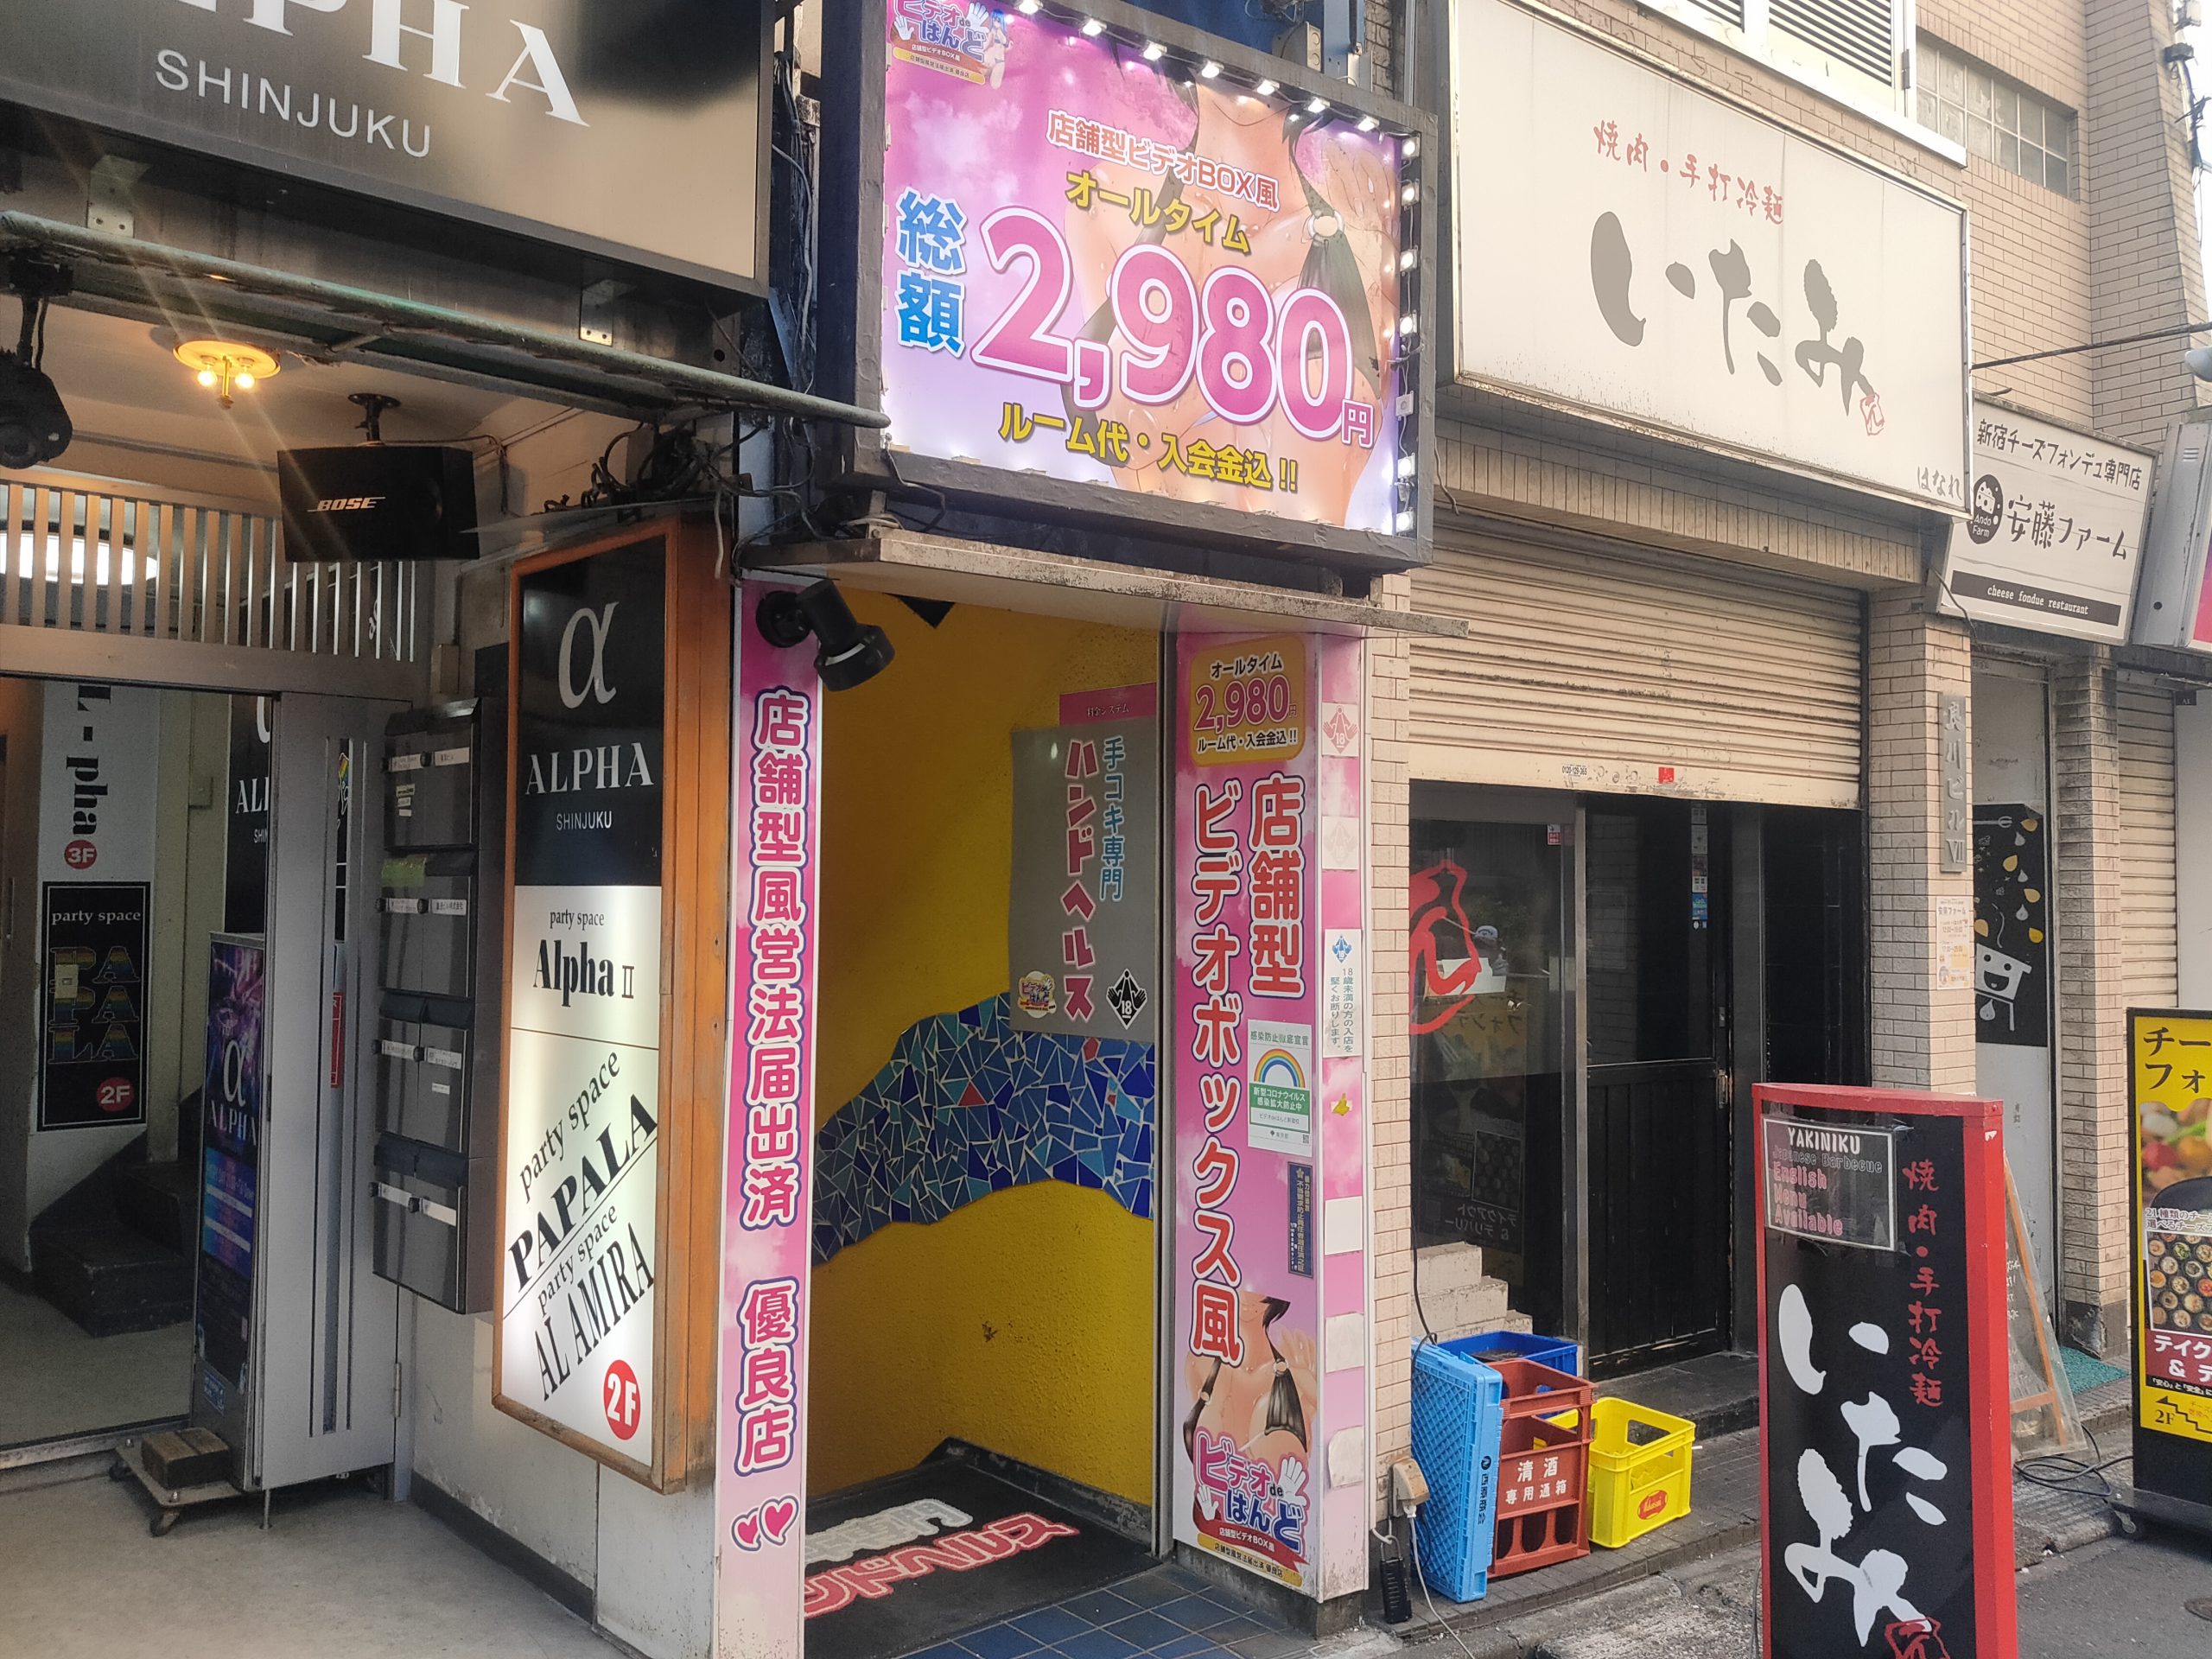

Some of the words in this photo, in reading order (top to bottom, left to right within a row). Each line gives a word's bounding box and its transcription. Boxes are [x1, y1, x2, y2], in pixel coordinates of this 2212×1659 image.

[920, 19, 986, 61] はんど
[156, 49, 431, 158] SHINJUKU
[1046, 111, 1280, 212] 店舗型ビデオBOX風
[1065, 171, 1252, 254] オールタイム
[894, 188, 966, 354] 総額
[971, 207, 1374, 448] 2,980円
[1591, 211, 1873, 416] いたみ
[1977, 417, 2142, 491] 新宿チーズフォンデュ専門店
[316, 497, 380, 512] BOSE
[1916, 467, 1962, 501] はなれ
[1973, 526, 1990, 537] Farm
[1974, 514, 1992, 525] Ando
[2007, 494, 2126, 560] 安藤ファーム
[1987, 585, 2013, 601] cheese
[2018, 591, 2044, 606] fondue
[2048, 599, 2089, 614] restaurant
[1211, 652, 1283, 679] オールタイム
[1336, 734, 1345, 745] 18
[524, 741, 654, 796] ALPHA
[556, 810, 613, 830] SHINJUKU
[1100, 735, 1125, 902] 手コキ専門
[67, 848, 96, 864] 3F
[1061, 739, 1098, 1022] ハンドヘルス
[1251, 775, 1303, 996] 店舗型
[52, 908, 93, 925] party
[99, 909, 141, 924] space
[550, 909, 575, 930] party
[577, 912, 605, 931] space
[533, 939, 614, 1007] Alpha
[744, 690, 809, 1227] 店舗型風営法届出済
[1122, 999, 1132, 1015] 18
[1192, 779, 1243, 1365] ビデオボックス風
[100, 1085, 130, 1104] 2F
[1254, 1086, 1306, 1102] 新型コロナウイルス
[1257, 1096, 1302, 1111] 感染拡大防止中
[518, 1115, 564, 1202] party
[567, 1051, 621, 1131] space
[1787, 1127, 1861, 1155] YAKINIKU
[1773, 1161, 1827, 1190] English
[1821, 1152, 1883, 1173] Barbecue
[508, 1093, 658, 1294] PAPALA
[1774, 1184, 1808, 1207] Menu
[1775, 1208, 1843, 1236] Available
[537, 1255, 575, 1318] party
[576, 1205, 618, 1267] space
[738, 1280, 797, 1471] 優良店
[607, 1374, 639, 1427] 2F
[2155, 1409, 2176, 1425] 2F
[1517, 1457, 1559, 1482] 清酒
[1778, 1284, 1948, 1648] いたみ
[1226, 1490, 1303, 1552] はんど
